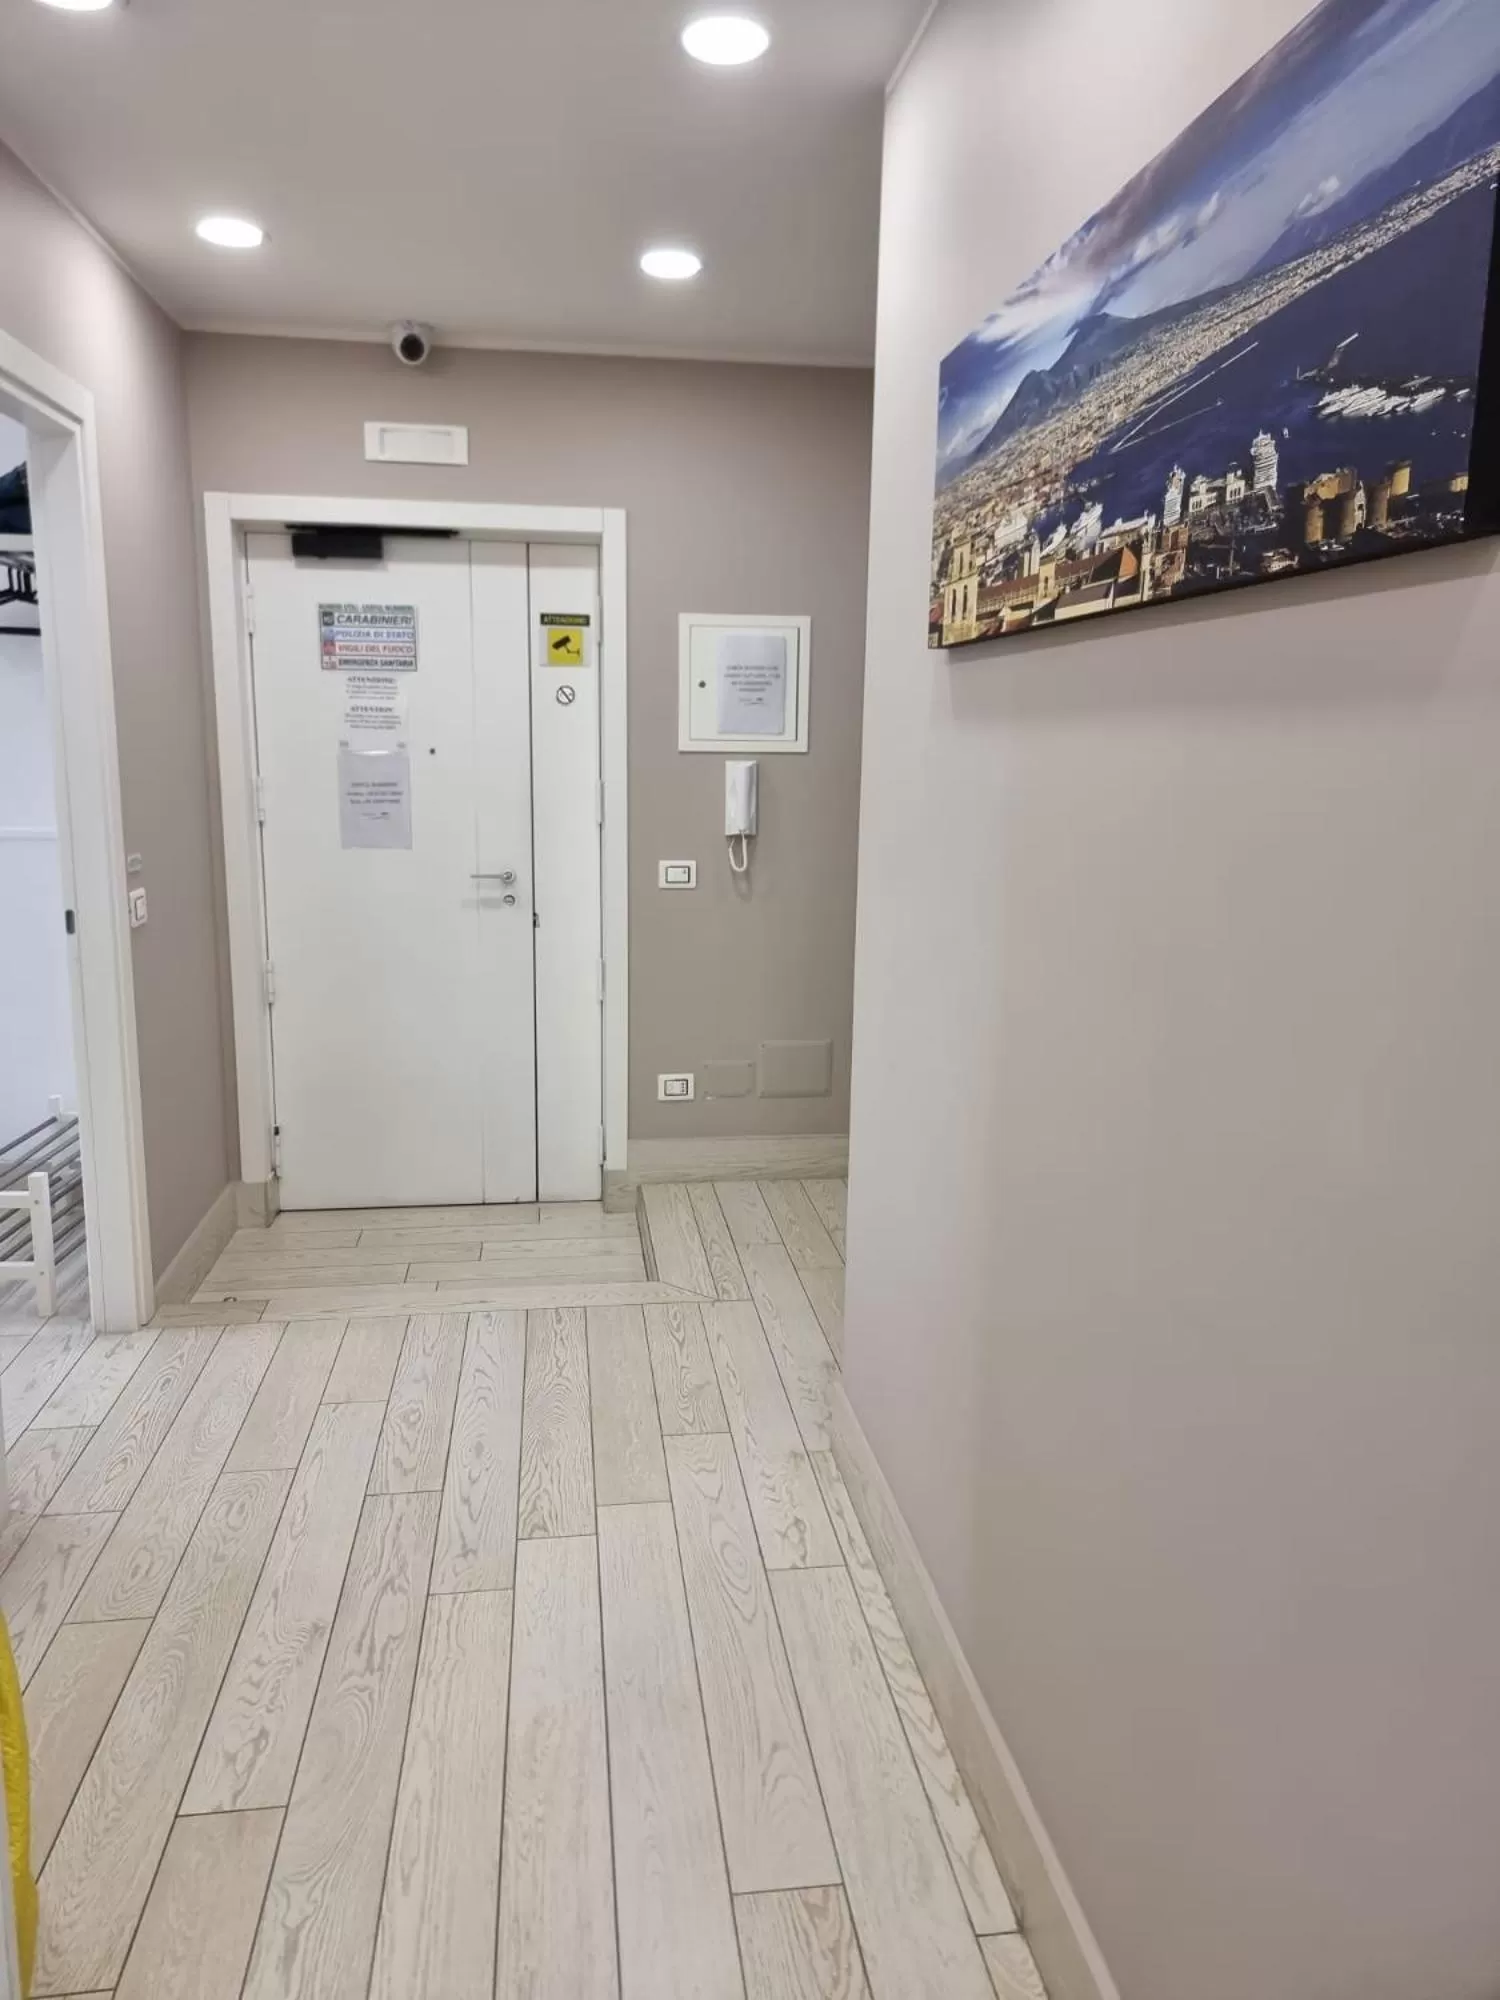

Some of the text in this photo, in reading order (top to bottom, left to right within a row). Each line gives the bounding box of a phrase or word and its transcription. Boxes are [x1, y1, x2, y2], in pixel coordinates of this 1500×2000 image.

[336, 614, 413, 626] CARABINIERI
[337, 631, 415, 640] POLIZIA DI STATO
[338, 644, 413, 654] VIGILI DEL FUOCO
[338, 658, 379, 667] EMERGENZA
[380, 659, 413, 667] SANITARIA
